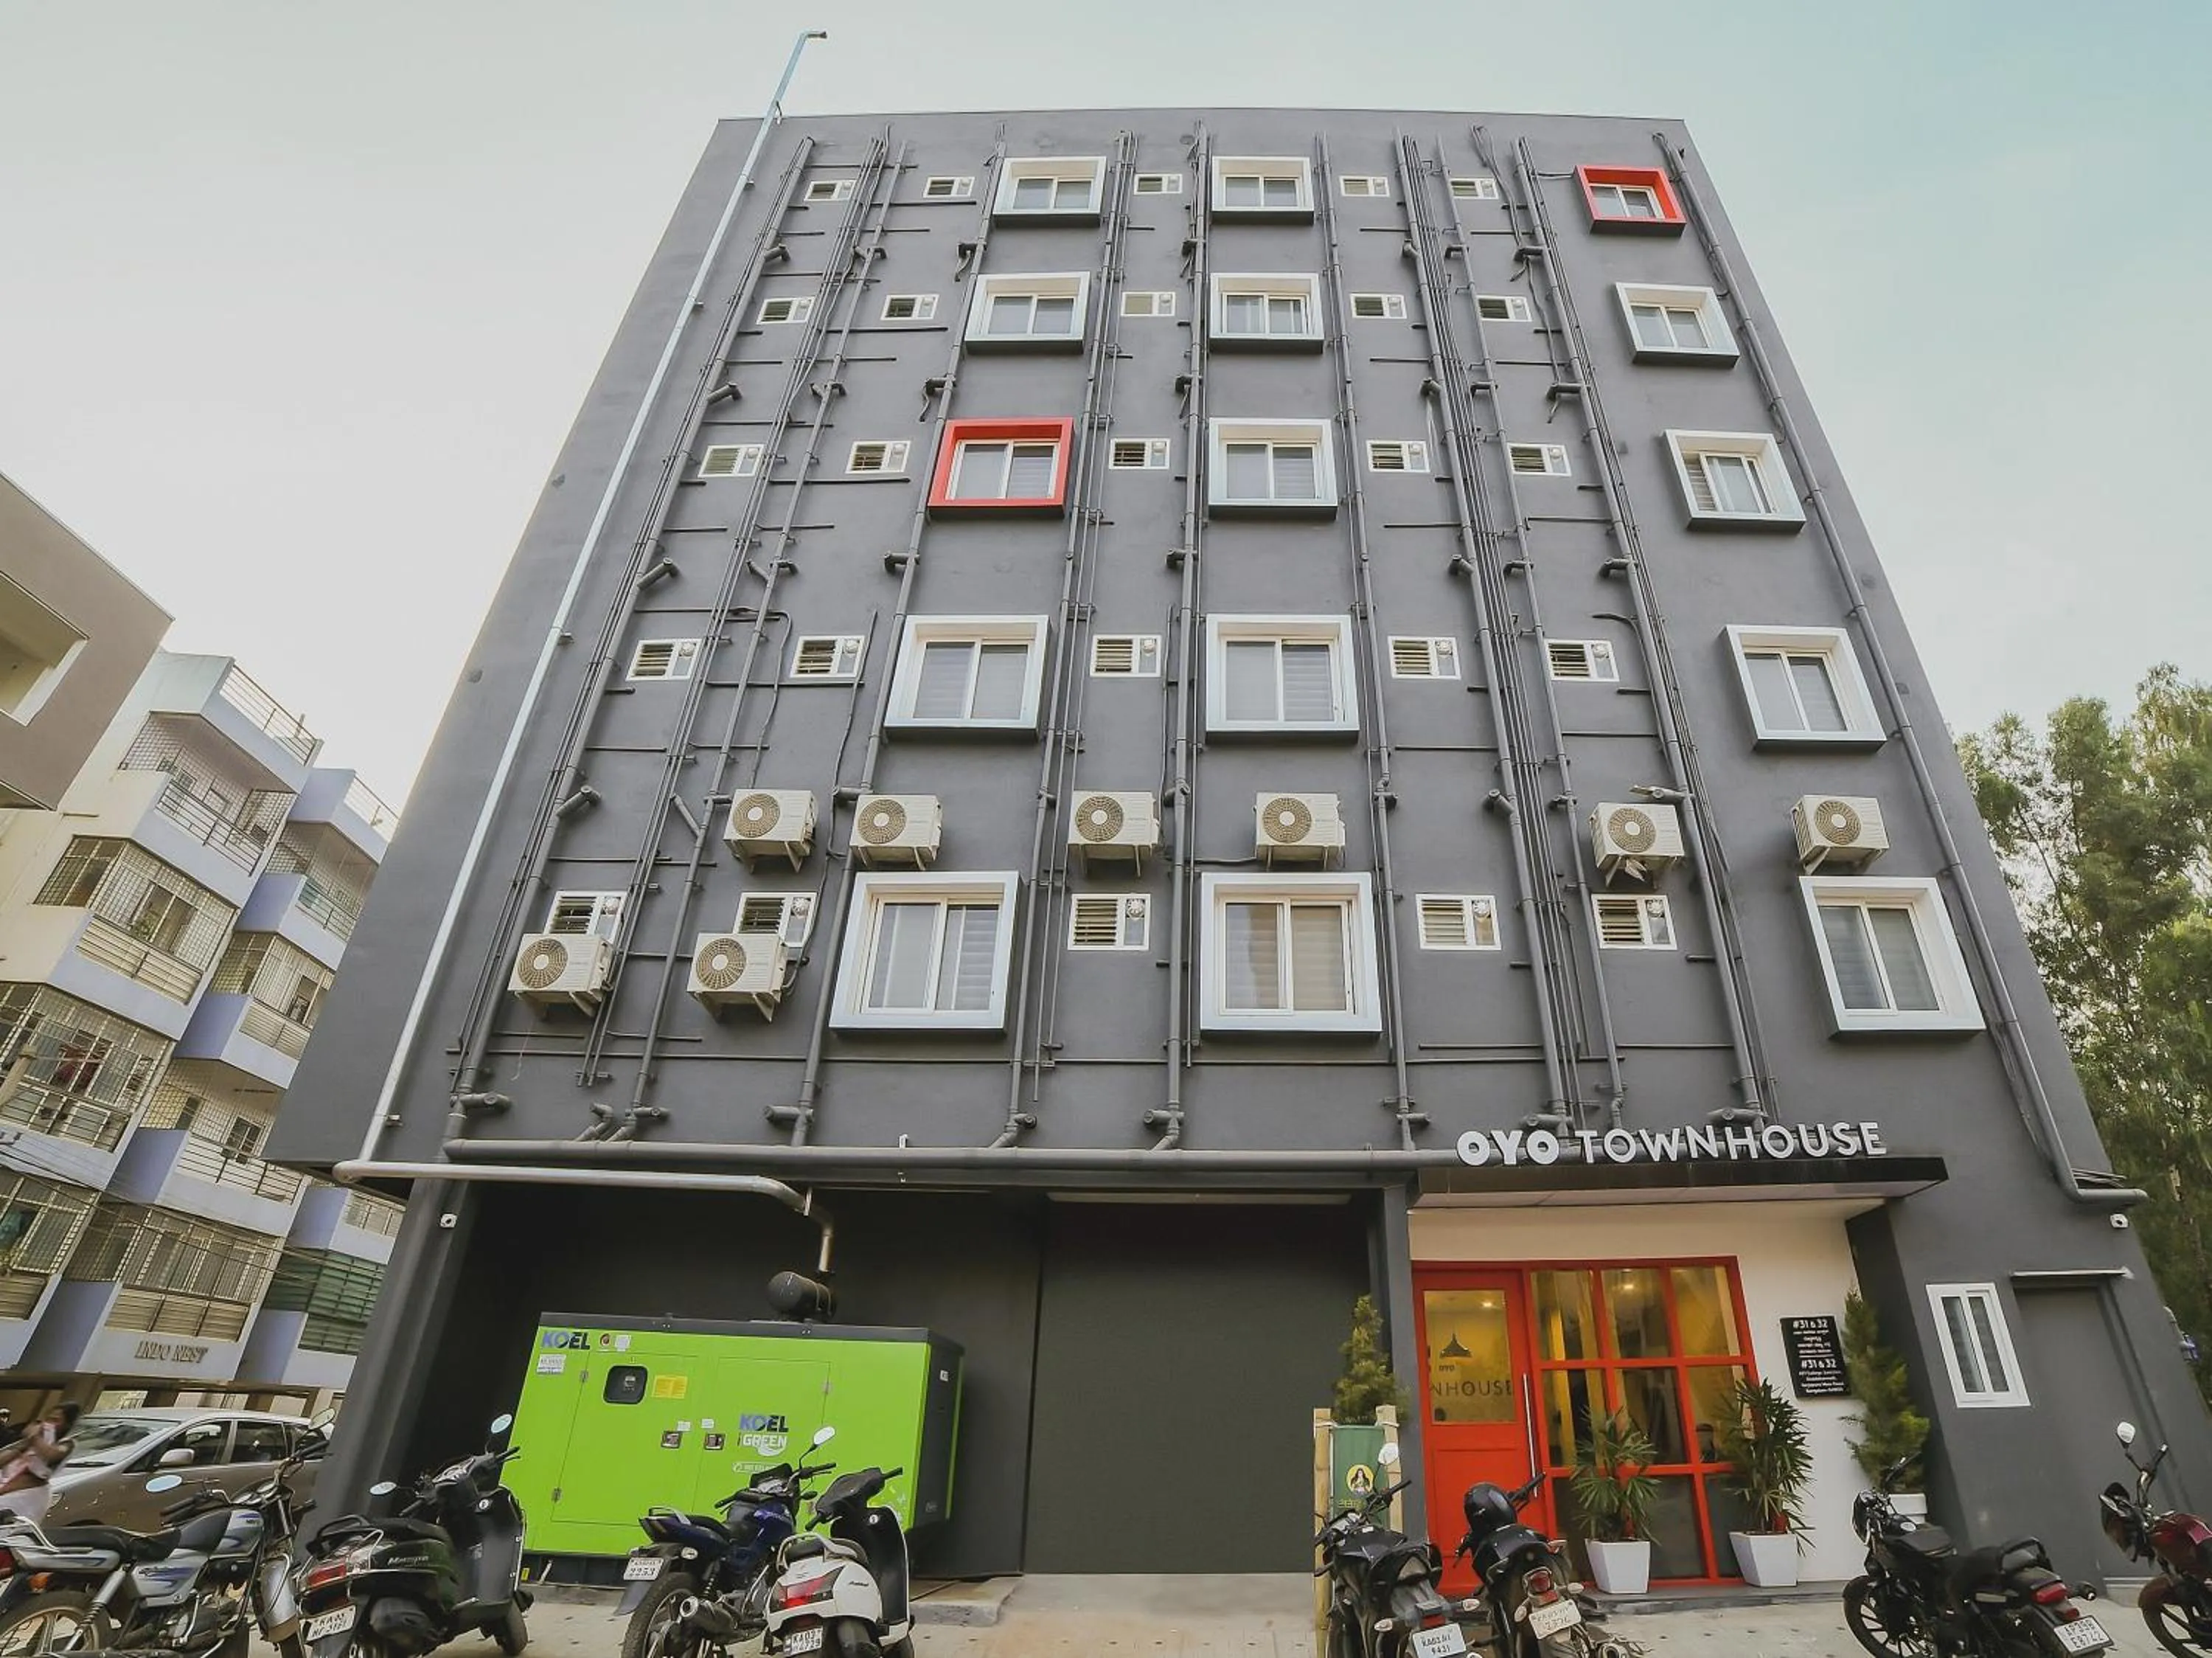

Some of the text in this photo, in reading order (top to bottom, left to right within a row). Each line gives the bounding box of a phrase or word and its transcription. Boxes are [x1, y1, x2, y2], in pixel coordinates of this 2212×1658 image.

[1457, 1122, 1887, 1166] OYO TOWNHOUSE
[542, 1331, 591, 1350] KOEL
[134, 1341, 209, 1364] INDO NEST
[740, 1414, 789, 1432] KOEL
[742, 1433, 787, 1449] GREEN
